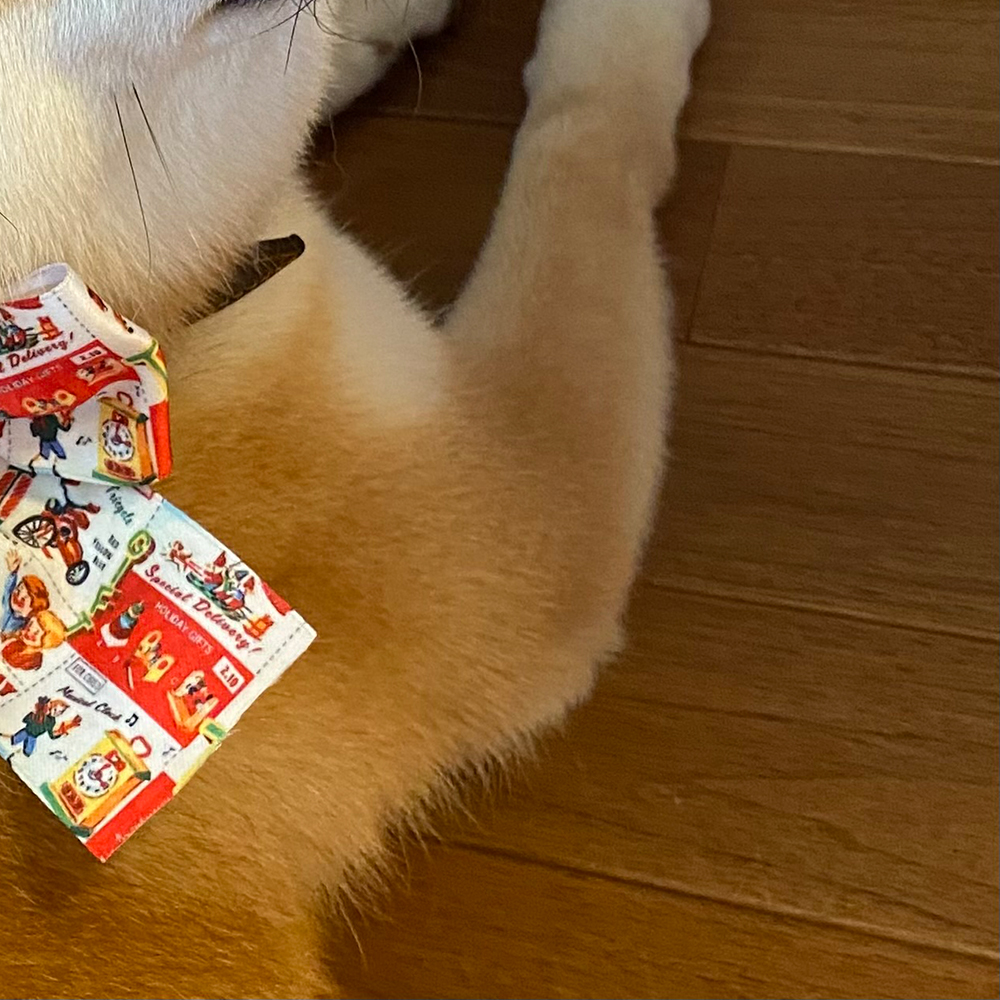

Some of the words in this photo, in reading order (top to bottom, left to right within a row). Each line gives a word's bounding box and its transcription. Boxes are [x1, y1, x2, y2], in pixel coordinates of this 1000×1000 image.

[6, 331, 74, 369] Delivery!
[144, 563, 194, 602] Special
[192, 599, 264, 654] Delivery!
[154, 601, 189, 634] HOLIDAY
[188, 629, 215, 655] GIFTS
[219, 665, 240, 689] 2.10
[94, 702, 123, 722] Clock
